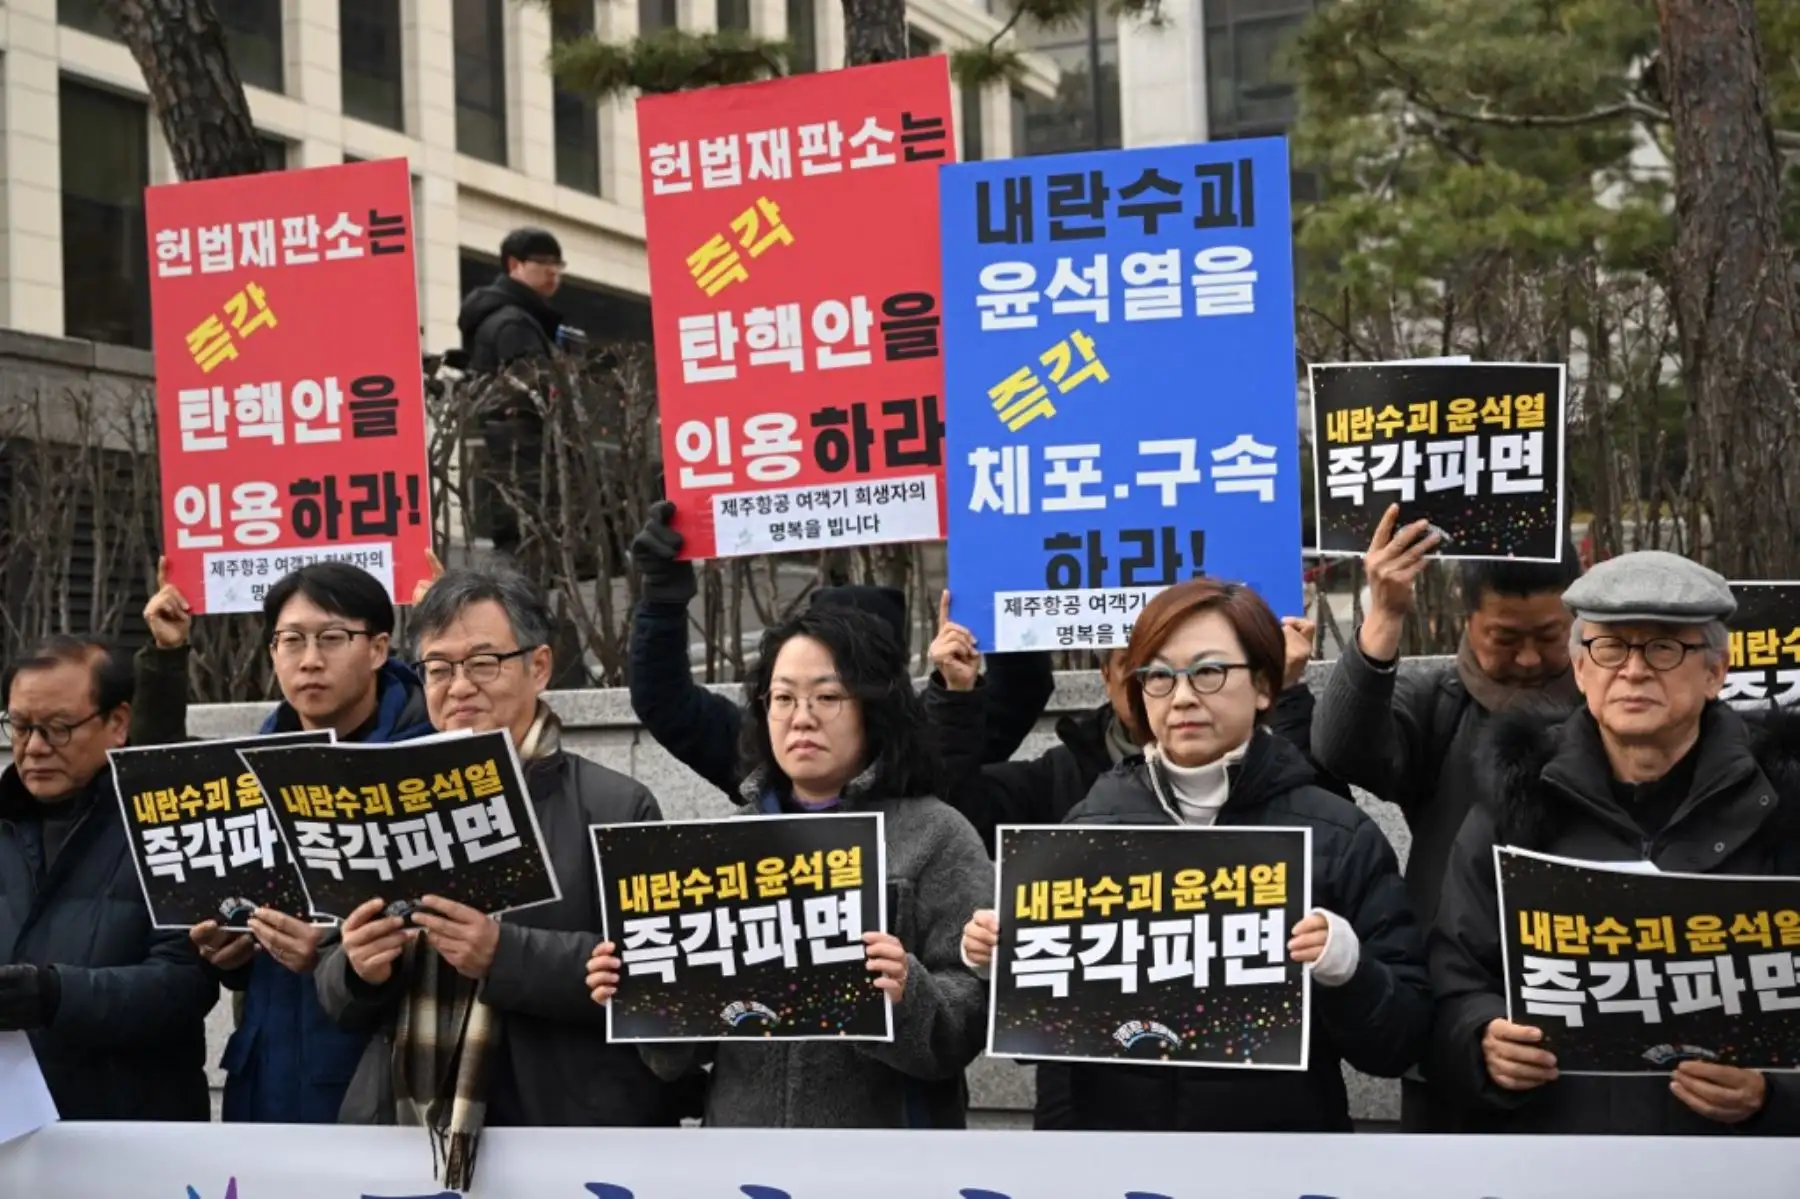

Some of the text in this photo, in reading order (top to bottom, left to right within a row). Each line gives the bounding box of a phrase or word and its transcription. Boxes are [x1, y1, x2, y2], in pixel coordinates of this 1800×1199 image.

[648, 112, 946, 196] 헌법재판소는
[975, 158, 1255, 245] 내란수괴
[156, 209, 406, 277] 헌법재판소는
[685, 196, 796, 297] 즉각
[976, 245, 1258, 331] 윤석열을
[185, 282, 278, 373] 즉각
[678, 292, 940, 384] 탄핵안을
[177, 375, 399, 452] 탄핵안을
[986, 329, 1110, 433] 즉각
[1326, 392, 1546, 444] 내란수괴 윤석열
[720, 480, 926, 517] 제주항공 여객기 희생자의
[967, 433, 1278, 515] 체포.구속
[1326, 431, 1544, 506] 즉각파면
[174, 471, 421, 549] 인용하라!
[769, 513, 880, 542] 명복을 빕니다
[210, 557, 269, 578] 제주항공
[1044, 526, 1206, 590] 하라!
[1004, 592, 1147, 617] 제주항공 여객기
[1056, 623, 1115, 646] 명복을
[133, 775, 231, 824] 내란수괴
[279, 758, 504, 820] 내란수괴 윤석열
[141, 808, 295, 883] 즉각파
[294, 795, 522, 882] 즉각파면
[618, 846, 863, 913] 내란수괴 윤석열
[1015, 862, 1288, 921] 내란수괴 윤석열
[621, 889, 866, 984] 즉각파면
[1011, 908, 1287, 998] 즉각파면
[1519, 910, 1677, 955] 내란수괴
